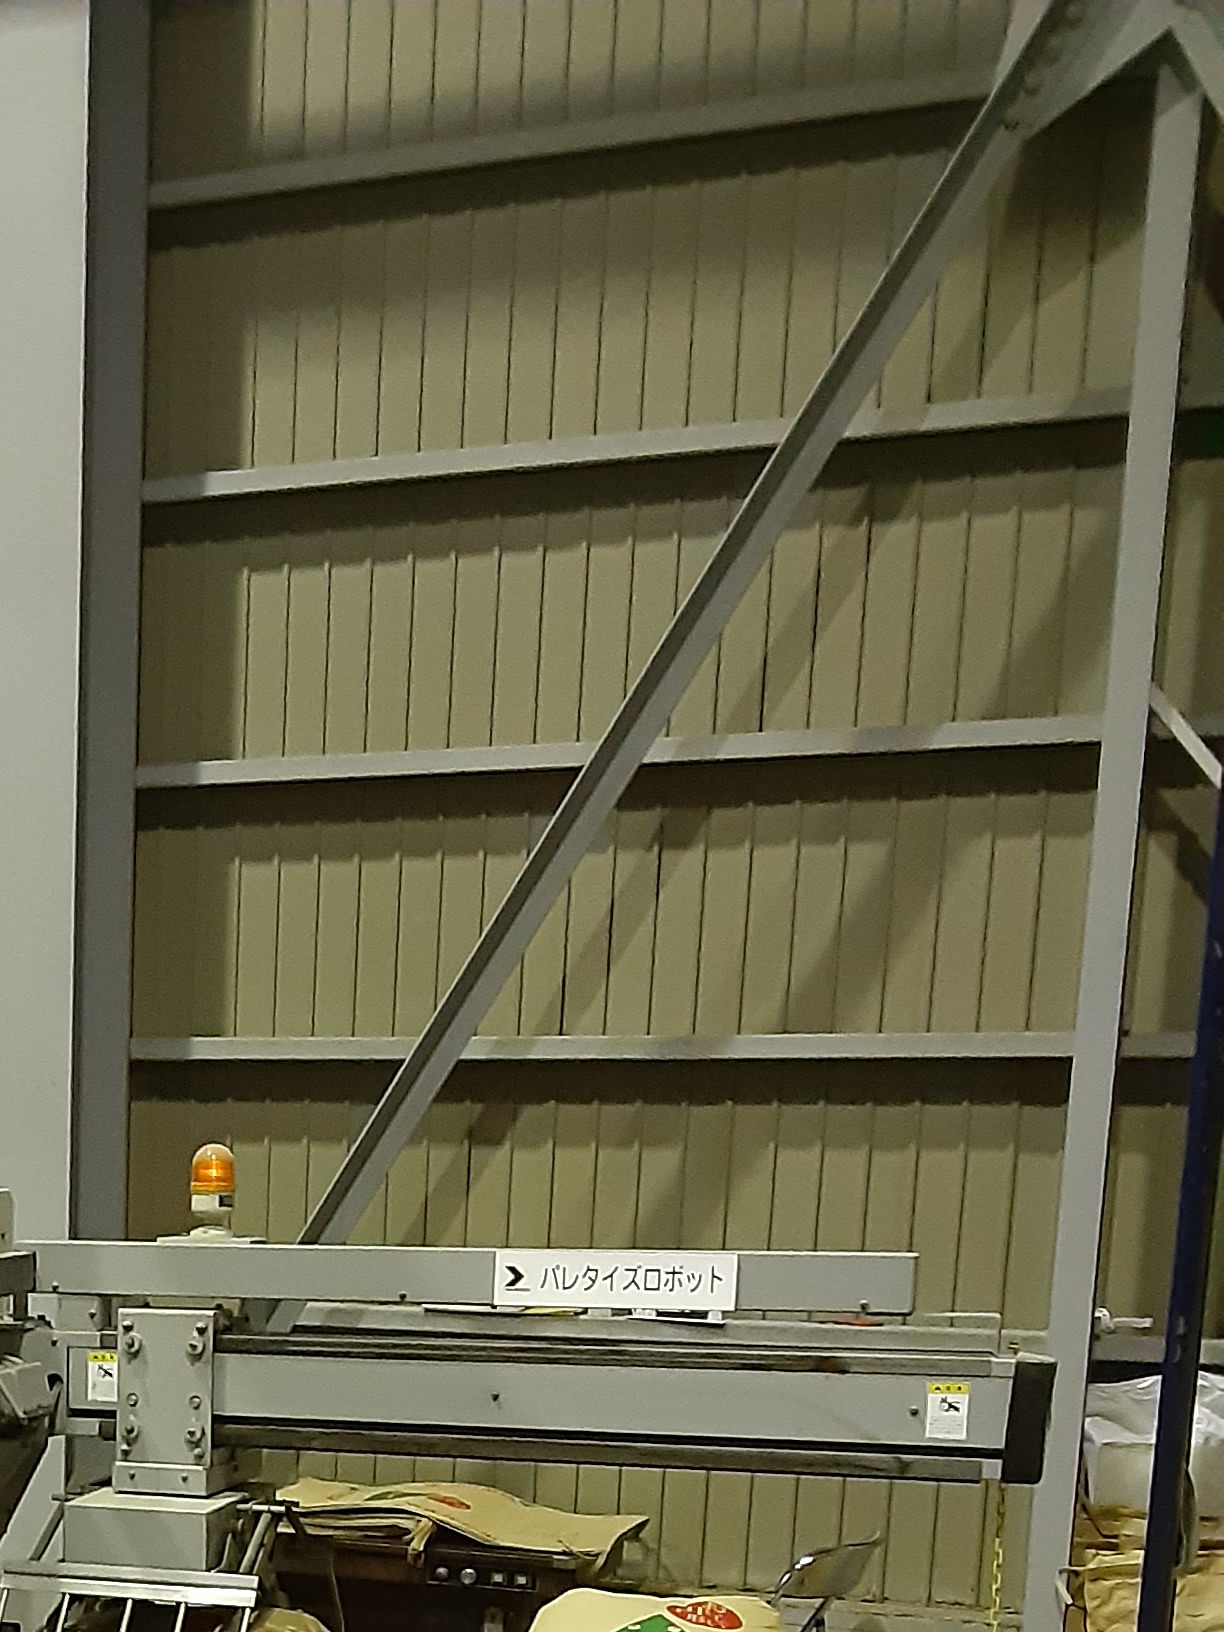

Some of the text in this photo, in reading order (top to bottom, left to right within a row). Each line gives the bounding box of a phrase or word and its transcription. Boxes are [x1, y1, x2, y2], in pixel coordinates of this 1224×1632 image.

[540, 1264, 723, 1293] パレタイズロボット
